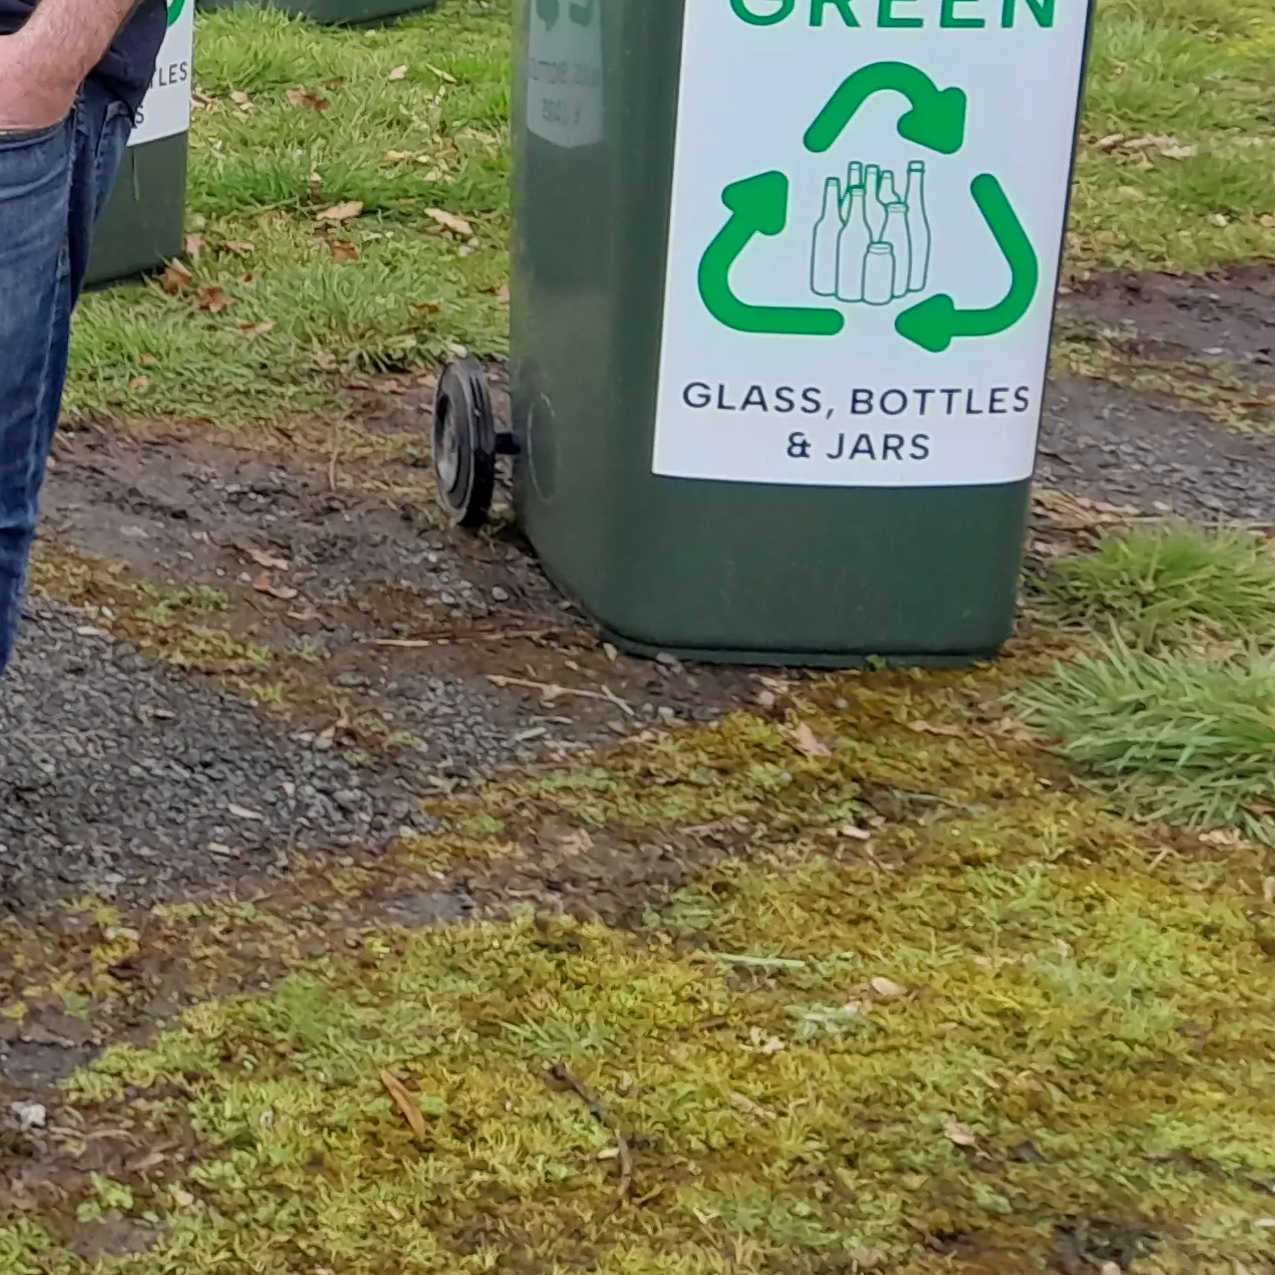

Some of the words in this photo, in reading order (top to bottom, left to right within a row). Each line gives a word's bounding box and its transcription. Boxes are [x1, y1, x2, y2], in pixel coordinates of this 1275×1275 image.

[149, 61, 188, 89] LES
[682, 381, 836, 421] GLASS,
[850, 385, 1030, 418] BOTTLES
[785, 432, 811, 461] &
[825, 433, 931, 463] JARS
